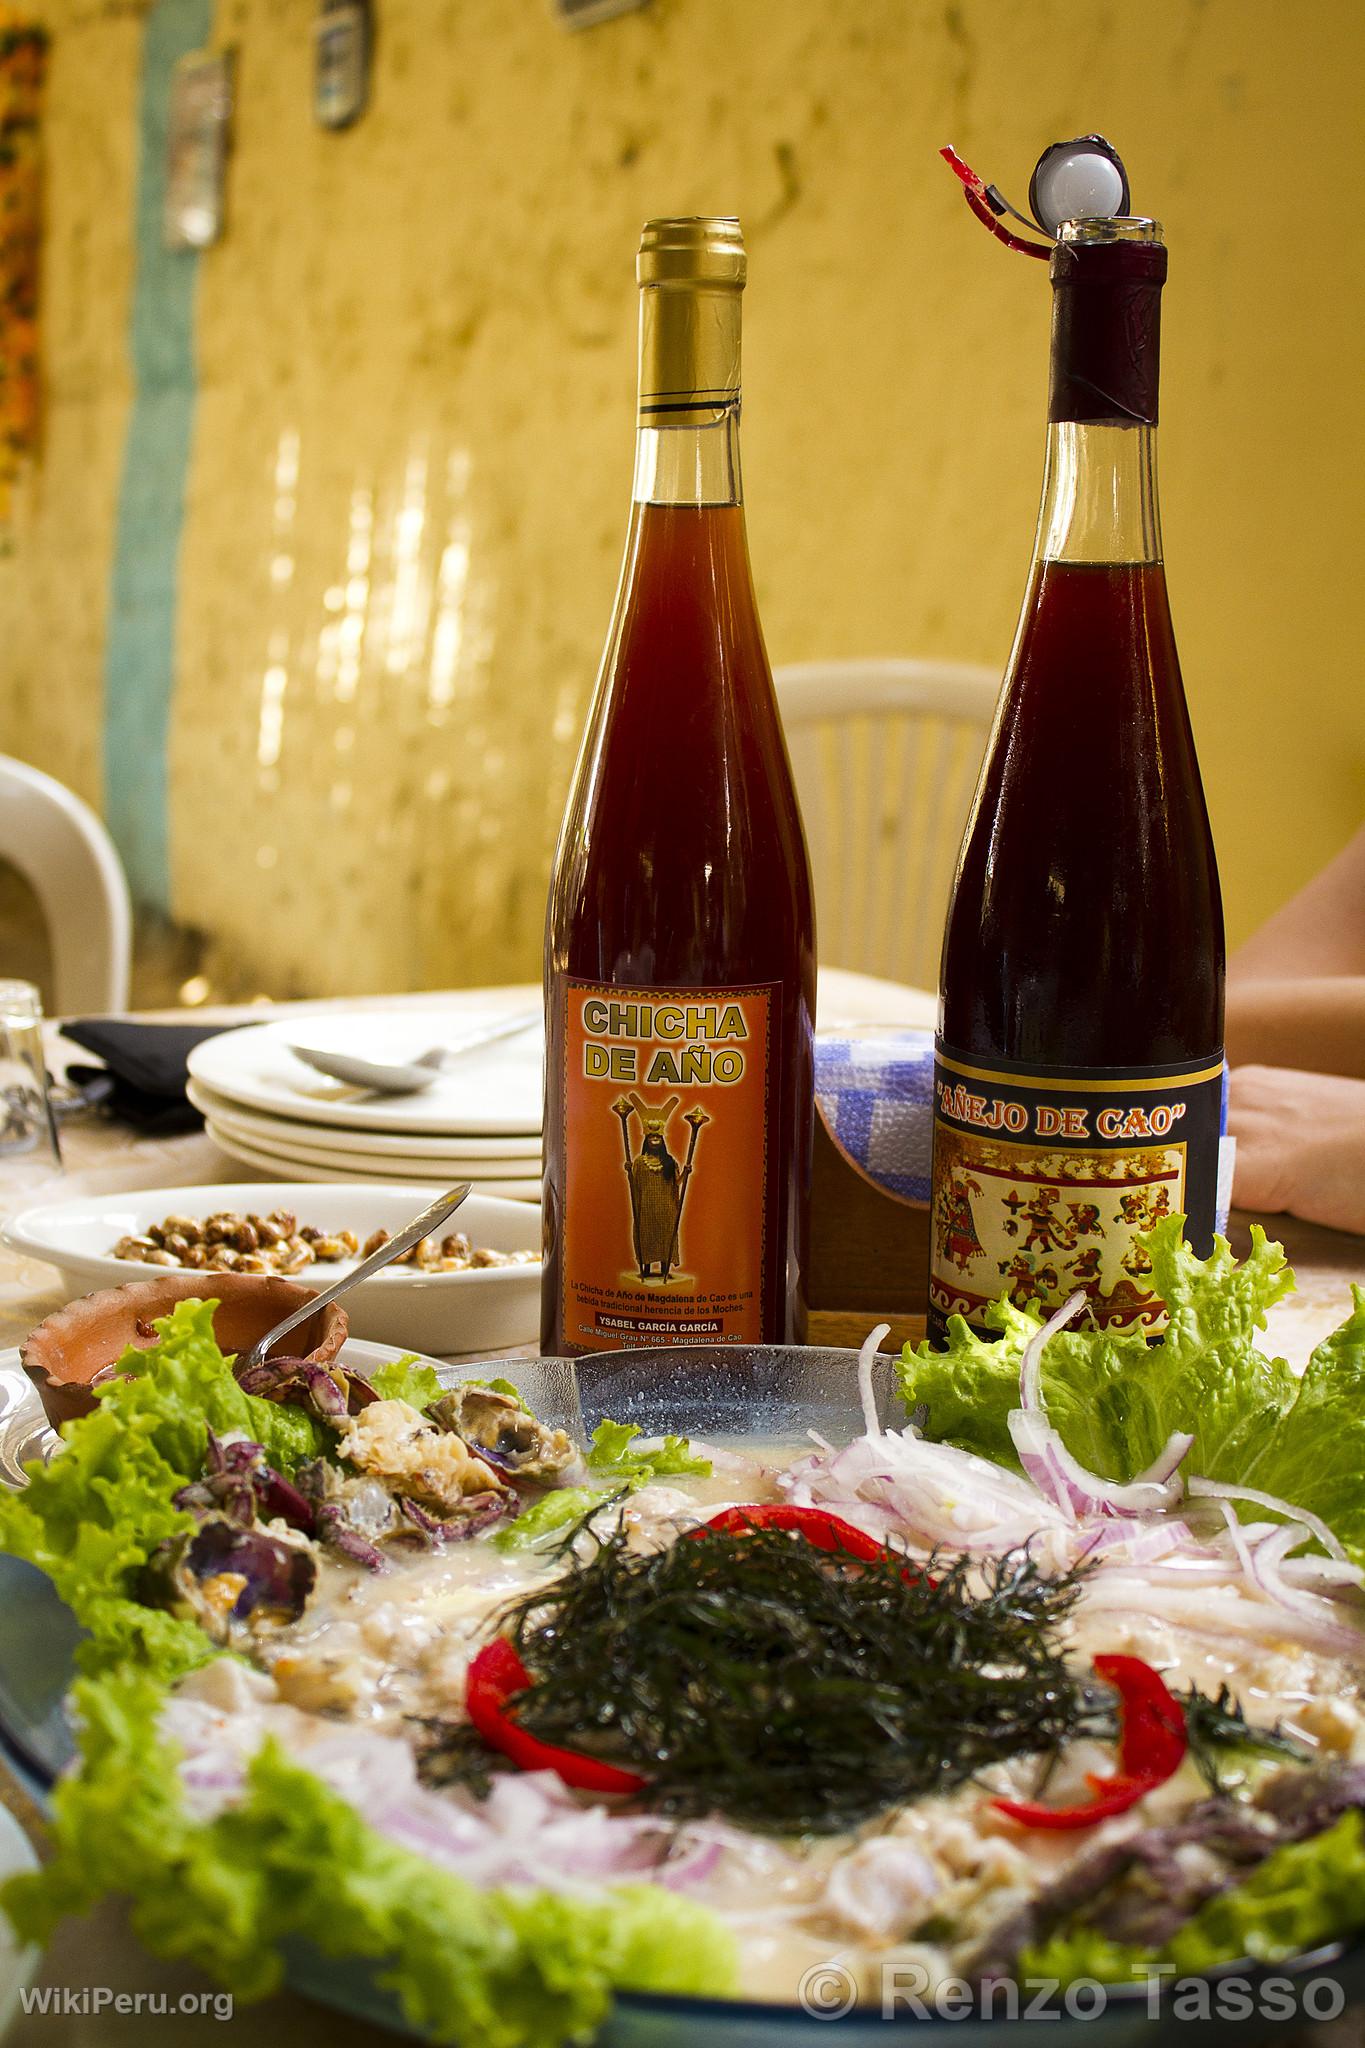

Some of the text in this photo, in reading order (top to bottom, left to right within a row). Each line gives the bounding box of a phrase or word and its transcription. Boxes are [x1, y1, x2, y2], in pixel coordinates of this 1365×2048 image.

[583, 1000, 748, 1040] CHICHA
[585, 1043, 744, 1083] DE AÑO
[1035, 1106, 1090, 1138] DE
[570, 1280, 579, 1290] La
[580, 1282, 604, 1297] Chicha
[605, 1289, 615, 1298] de
[616, 1289, 633, 1301] Año
[635, 1293, 646, 1302] de
[647, 1293, 696, 1305] Magdalena
[696, 1294, 707, 1303] de
[709, 1293, 726, 1303] Cao
[739, 1290, 753, 1300] una
[576, 1294, 599, 1307] bebida
[600, 1300, 643, 1313] tradicional
[644, 1304, 682, 1315] herencia
[684, 1305, 695, 1315] de
[697, 1305, 710, 1315] los
[599, 1316, 719, 1332] YSABEL GARCÍA GARCÍA
[595, 1328, 619, 1340] Miguel
[619, 1333, 639, 1342] Grau
[651, 1336, 666, 1344] 665
[672, 1336, 715, 1346] Magdalena
[716, 1335, 726, 1343] de
[727, 1333, 742, 1342] Cao
